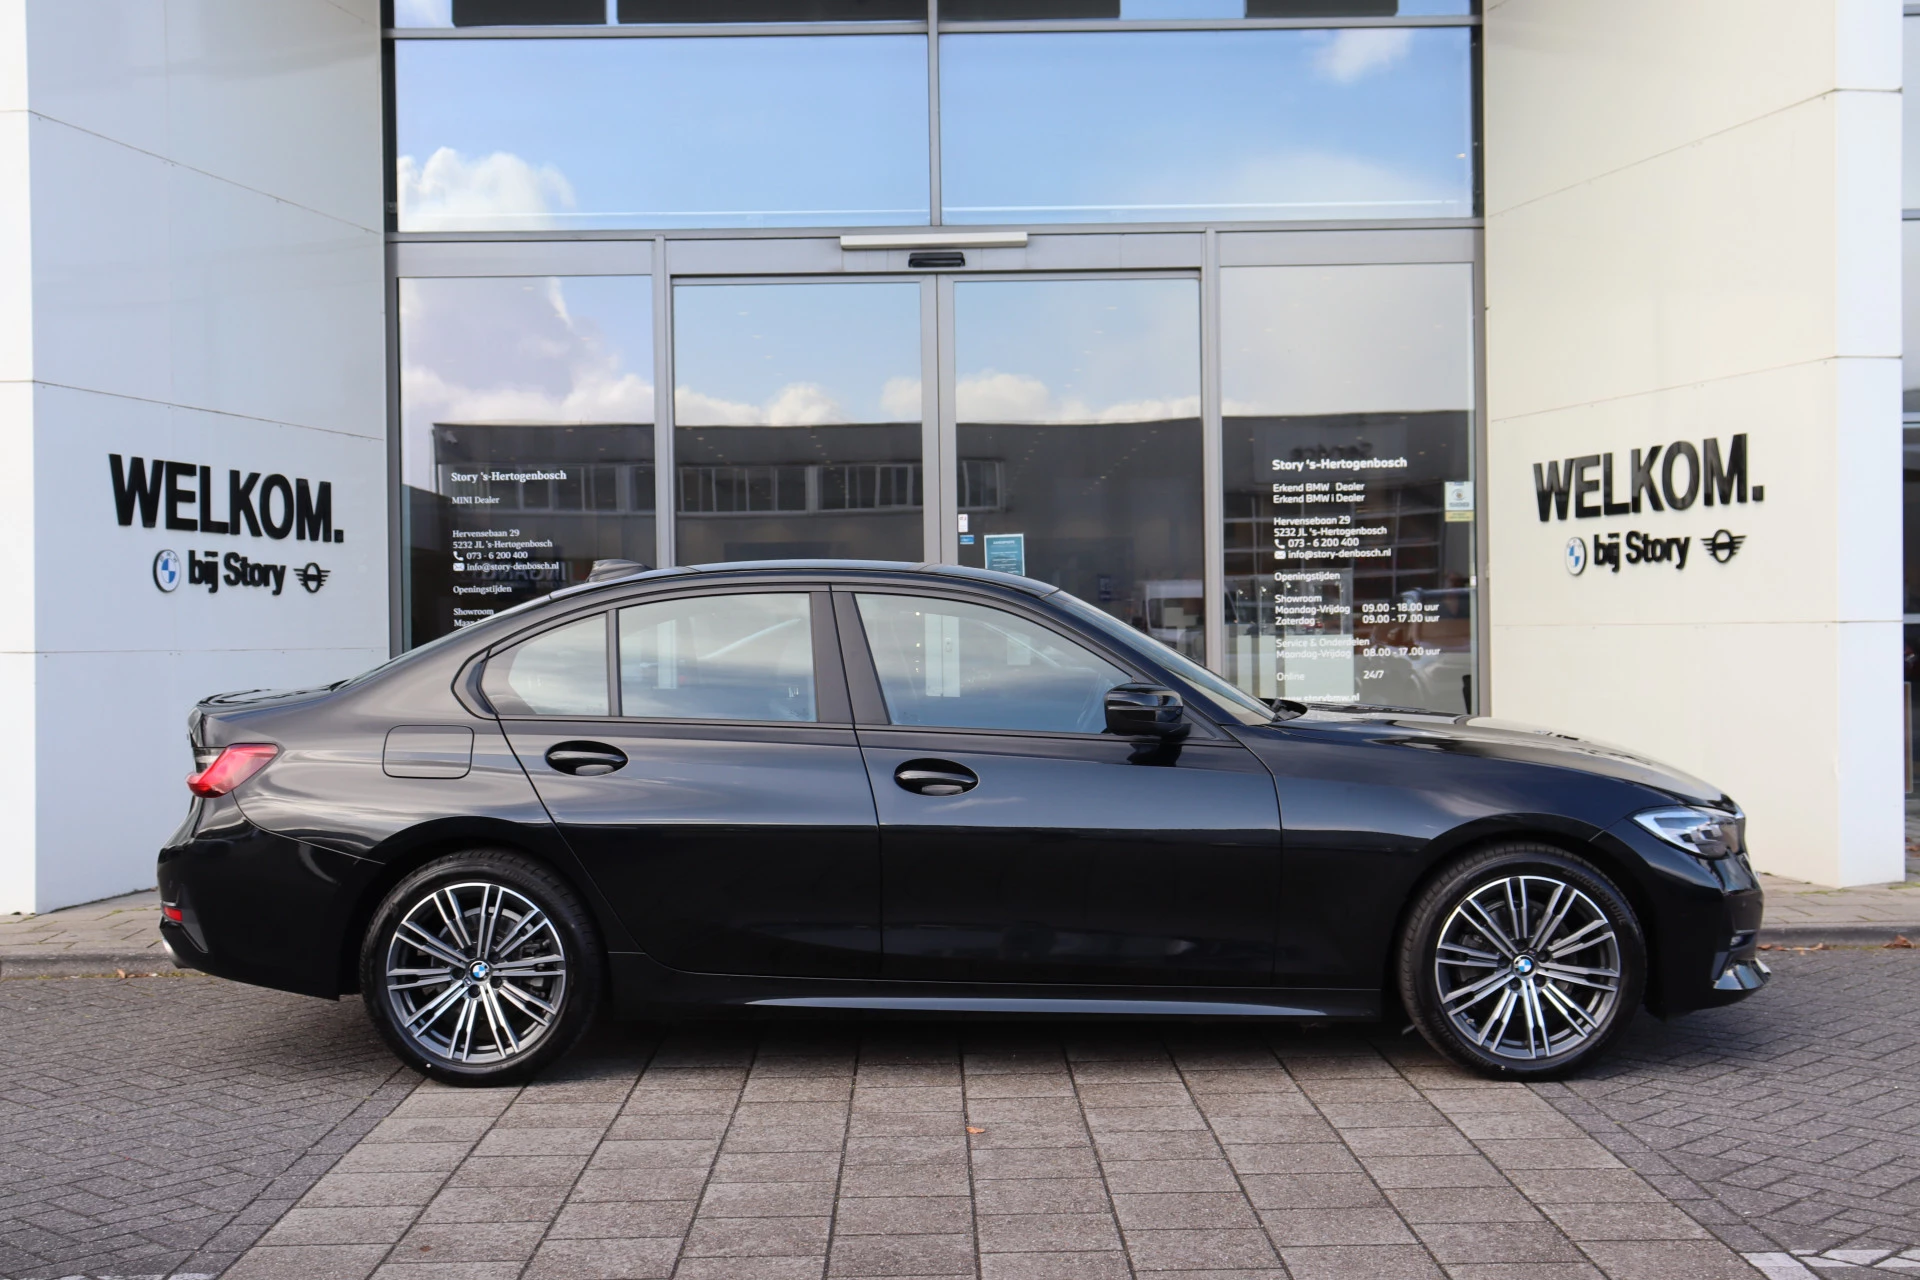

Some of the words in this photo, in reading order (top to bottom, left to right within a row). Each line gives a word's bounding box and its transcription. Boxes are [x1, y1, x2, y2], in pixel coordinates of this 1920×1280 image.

[1272, 459, 1304, 472] Story
[451, 472, 479, 484] Story
[480, 470, 568, 483] 's-Hertogenbosch
[1533, 433, 1764, 522] WELKOM.
[1272, 483, 1304, 492] Erkend
[1305, 482, 1330, 491] BMW
[1335, 482, 1365, 491] Dealer
[108, 453, 344, 543] WELKOM.
[451, 496, 473, 504] MINI
[474, 496, 500, 504] Dealer
[1272, 494, 1304, 503] Erkend
[1305, 493, 1330, 502] BMW
[1331, 493, 1335, 502] i
[1336, 493, 1365, 502] Dealer
[1273, 517, 1337, 526] Hervensebaan
[1338, 516, 1351, 525] 29
[452, 529, 508, 538] Hervensebaan
[509, 529, 520, 537] 29
[1273, 528, 1296, 537] 5232
[1297, 528, 1308, 537] JL
[1309, 526, 1387, 537] 's-Hertogenbosch
[452, 541, 473, 549] 5232
[486, 540, 553, 550] 's-Hertogenbosch
[1287, 539, 1305, 548] 073
[1312, 539, 1320, 547] 6
[1321, 538, 1340, 547] 200
[1340, 537, 1360, 546] 400
[466, 552, 482, 560] 073
[495, 551, 511, 559] 200
[512, 551, 529, 559] 400
[1288, 548, 1392, 560] info@story-denbosch.nl
[1625, 530, 1691, 570] Story
[466, 562, 560, 572] info@story-denbosch.nl
[223, 552, 286, 595] Story
[1274, 572, 1341, 583] Openingstijden
[452, 585, 513, 595] Openingstijden
[1274, 594, 1322, 603] Showroom
[453, 607, 495, 616] Showroom
[1275, 604, 1351, 615] Maandag-Vrijdag
[1362, 603, 1390, 613] 09.00
[1397, 602, 1423, 612] 18.00
[1424, 604, 1440, 612] uur
[1275, 616, 1315, 627] Zaterdag
[1362, 614, 1390, 624] 09.00
[1424, 615, 1440, 623] uur
[1363, 647, 1391, 657] 08.00
[1425, 648, 1441, 656] uur
[1276, 671, 1305, 681] Online
[1363, 670, 1384, 679] 24/7
